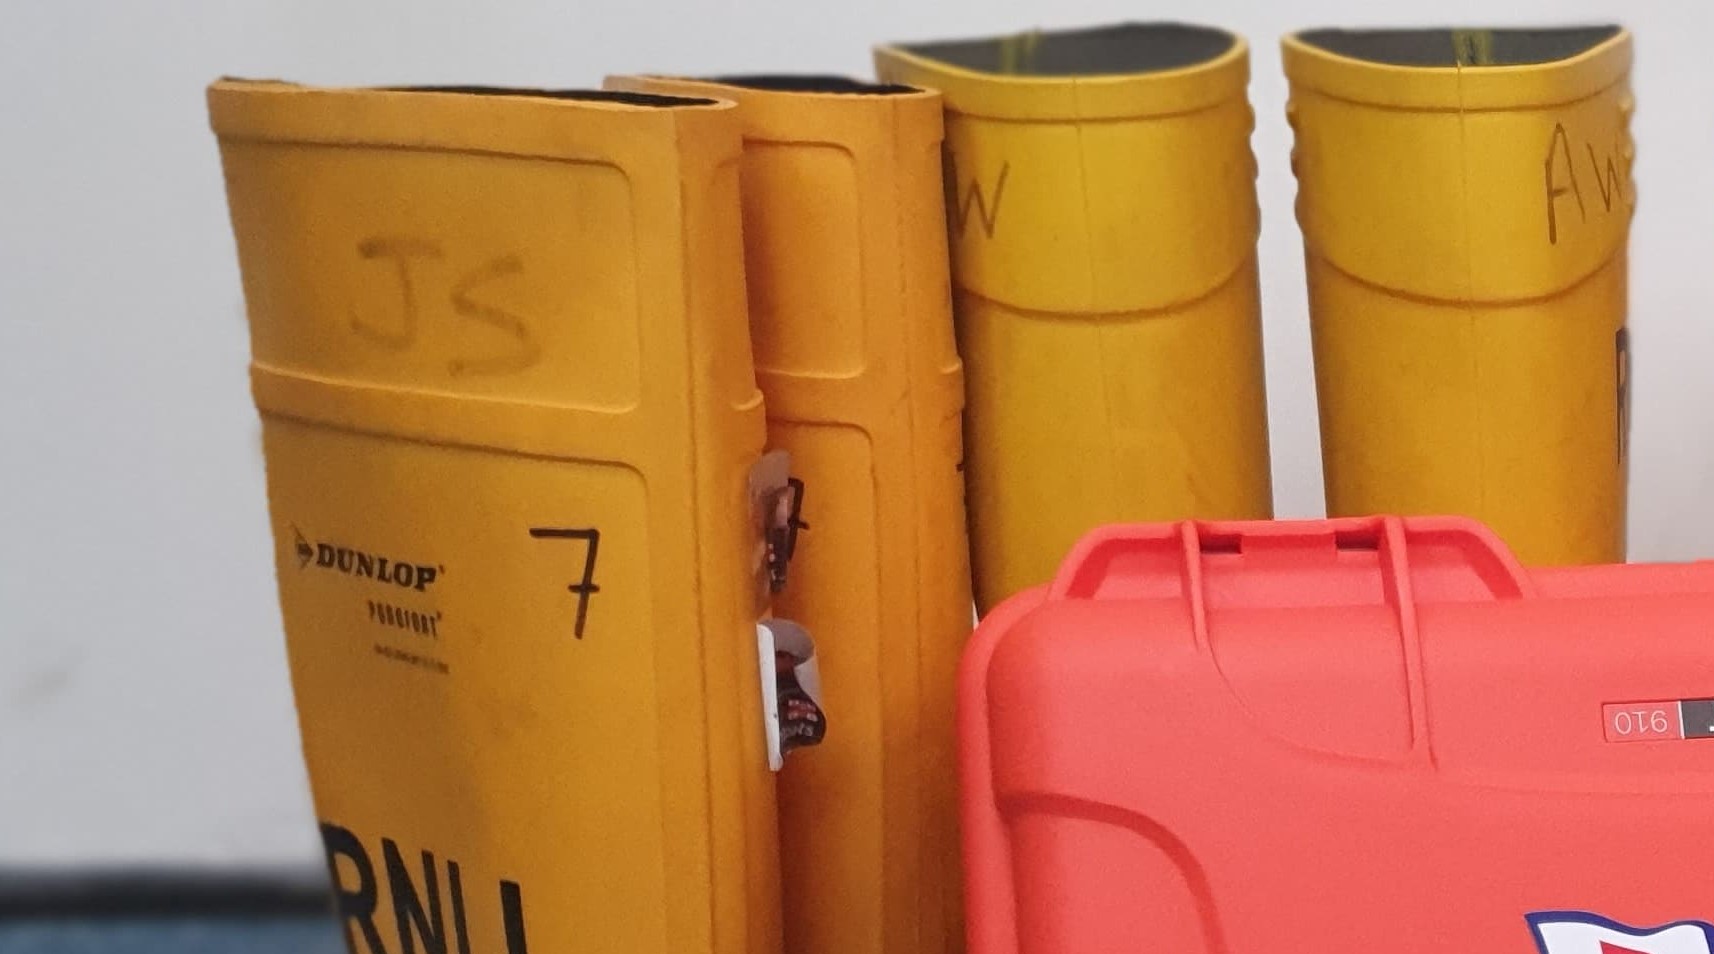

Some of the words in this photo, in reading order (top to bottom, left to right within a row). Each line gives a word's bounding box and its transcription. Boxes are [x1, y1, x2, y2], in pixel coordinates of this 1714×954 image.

[1545, 122, 1624, 245] AW
[350, 236, 543, 376] JS
[316, 543, 437, 592] DUNLOP
[528, 527, 600, 640] 7
[1613, 709, 1669, 735] 910
